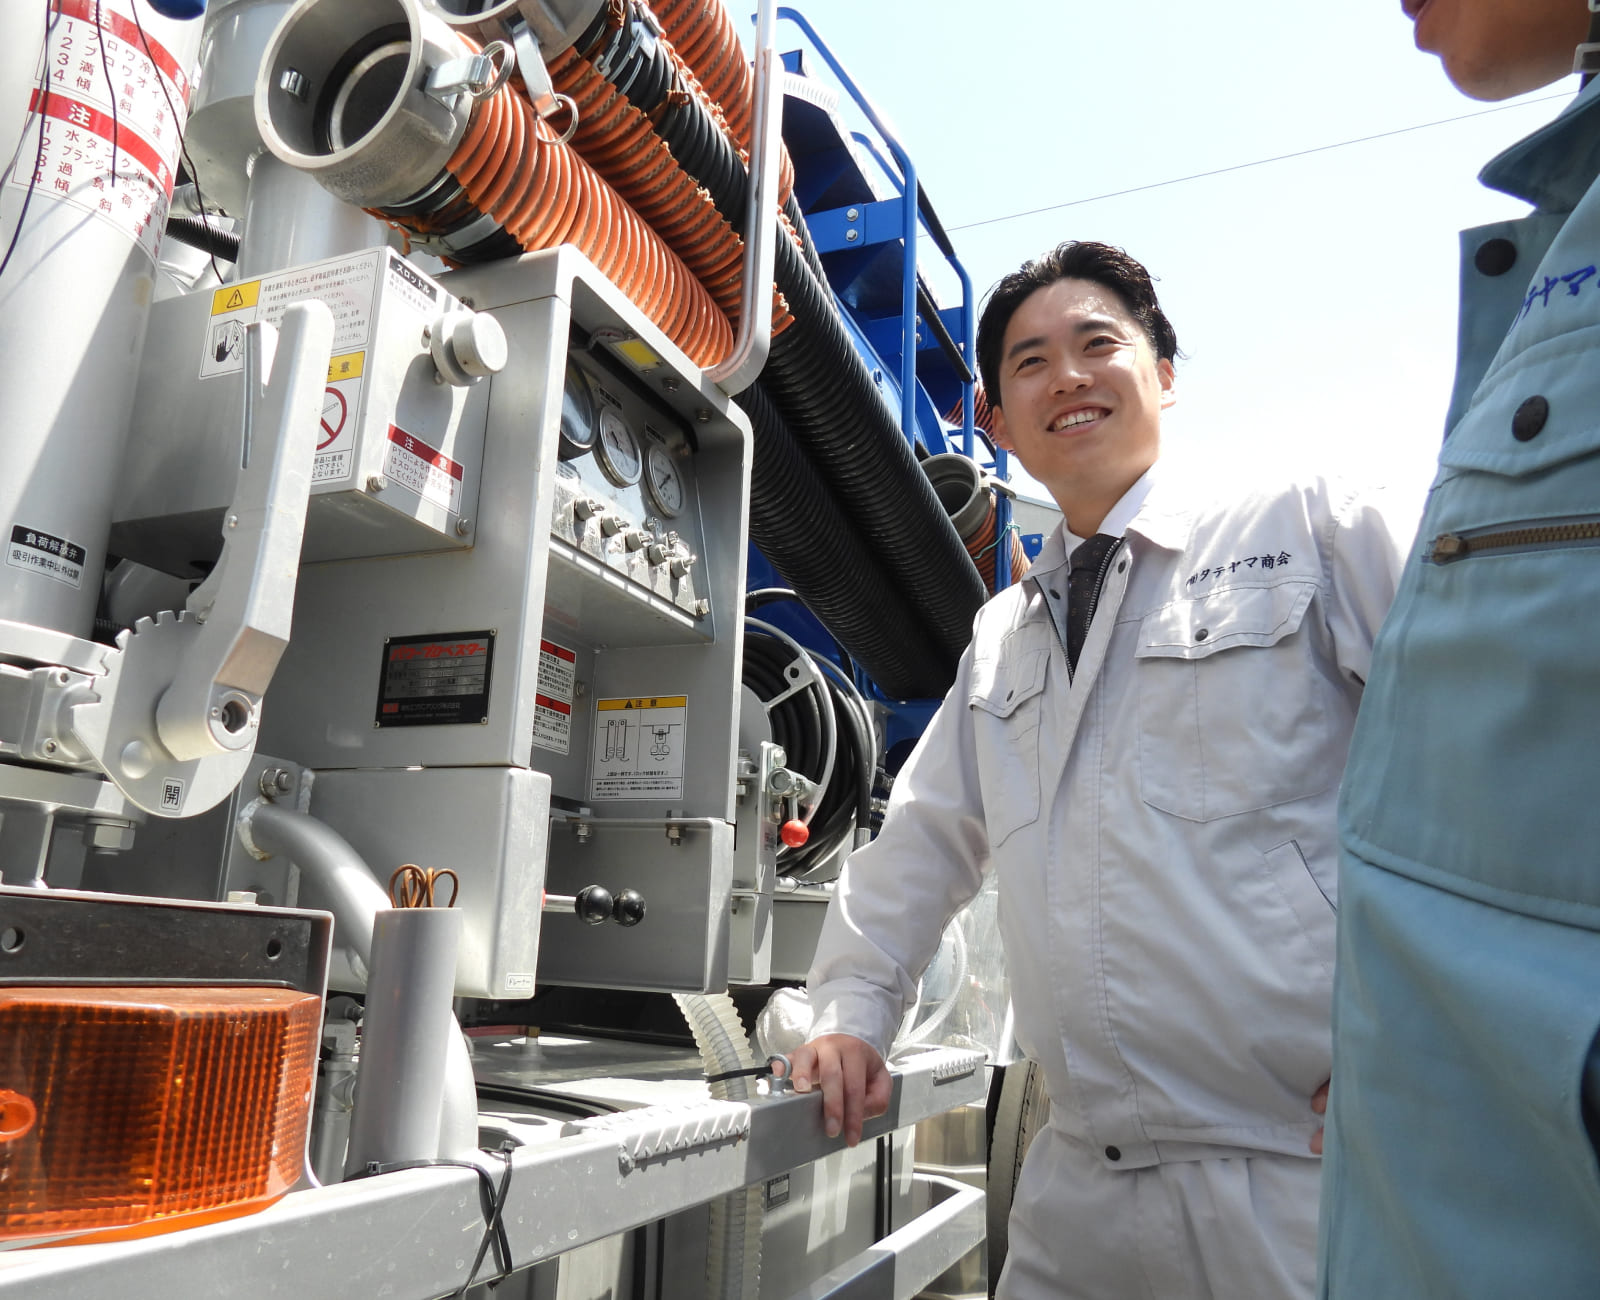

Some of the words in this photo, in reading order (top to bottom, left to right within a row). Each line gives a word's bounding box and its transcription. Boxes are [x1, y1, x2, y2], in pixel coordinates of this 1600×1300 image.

[66, 21, 73, 33] 1
[60, 37, 73, 50] 2
[57, 52, 70, 66] 3
[53, 69, 65, 81] 4
[396, 264, 430, 294] スロットル
[164, 784, 181, 806] 開
